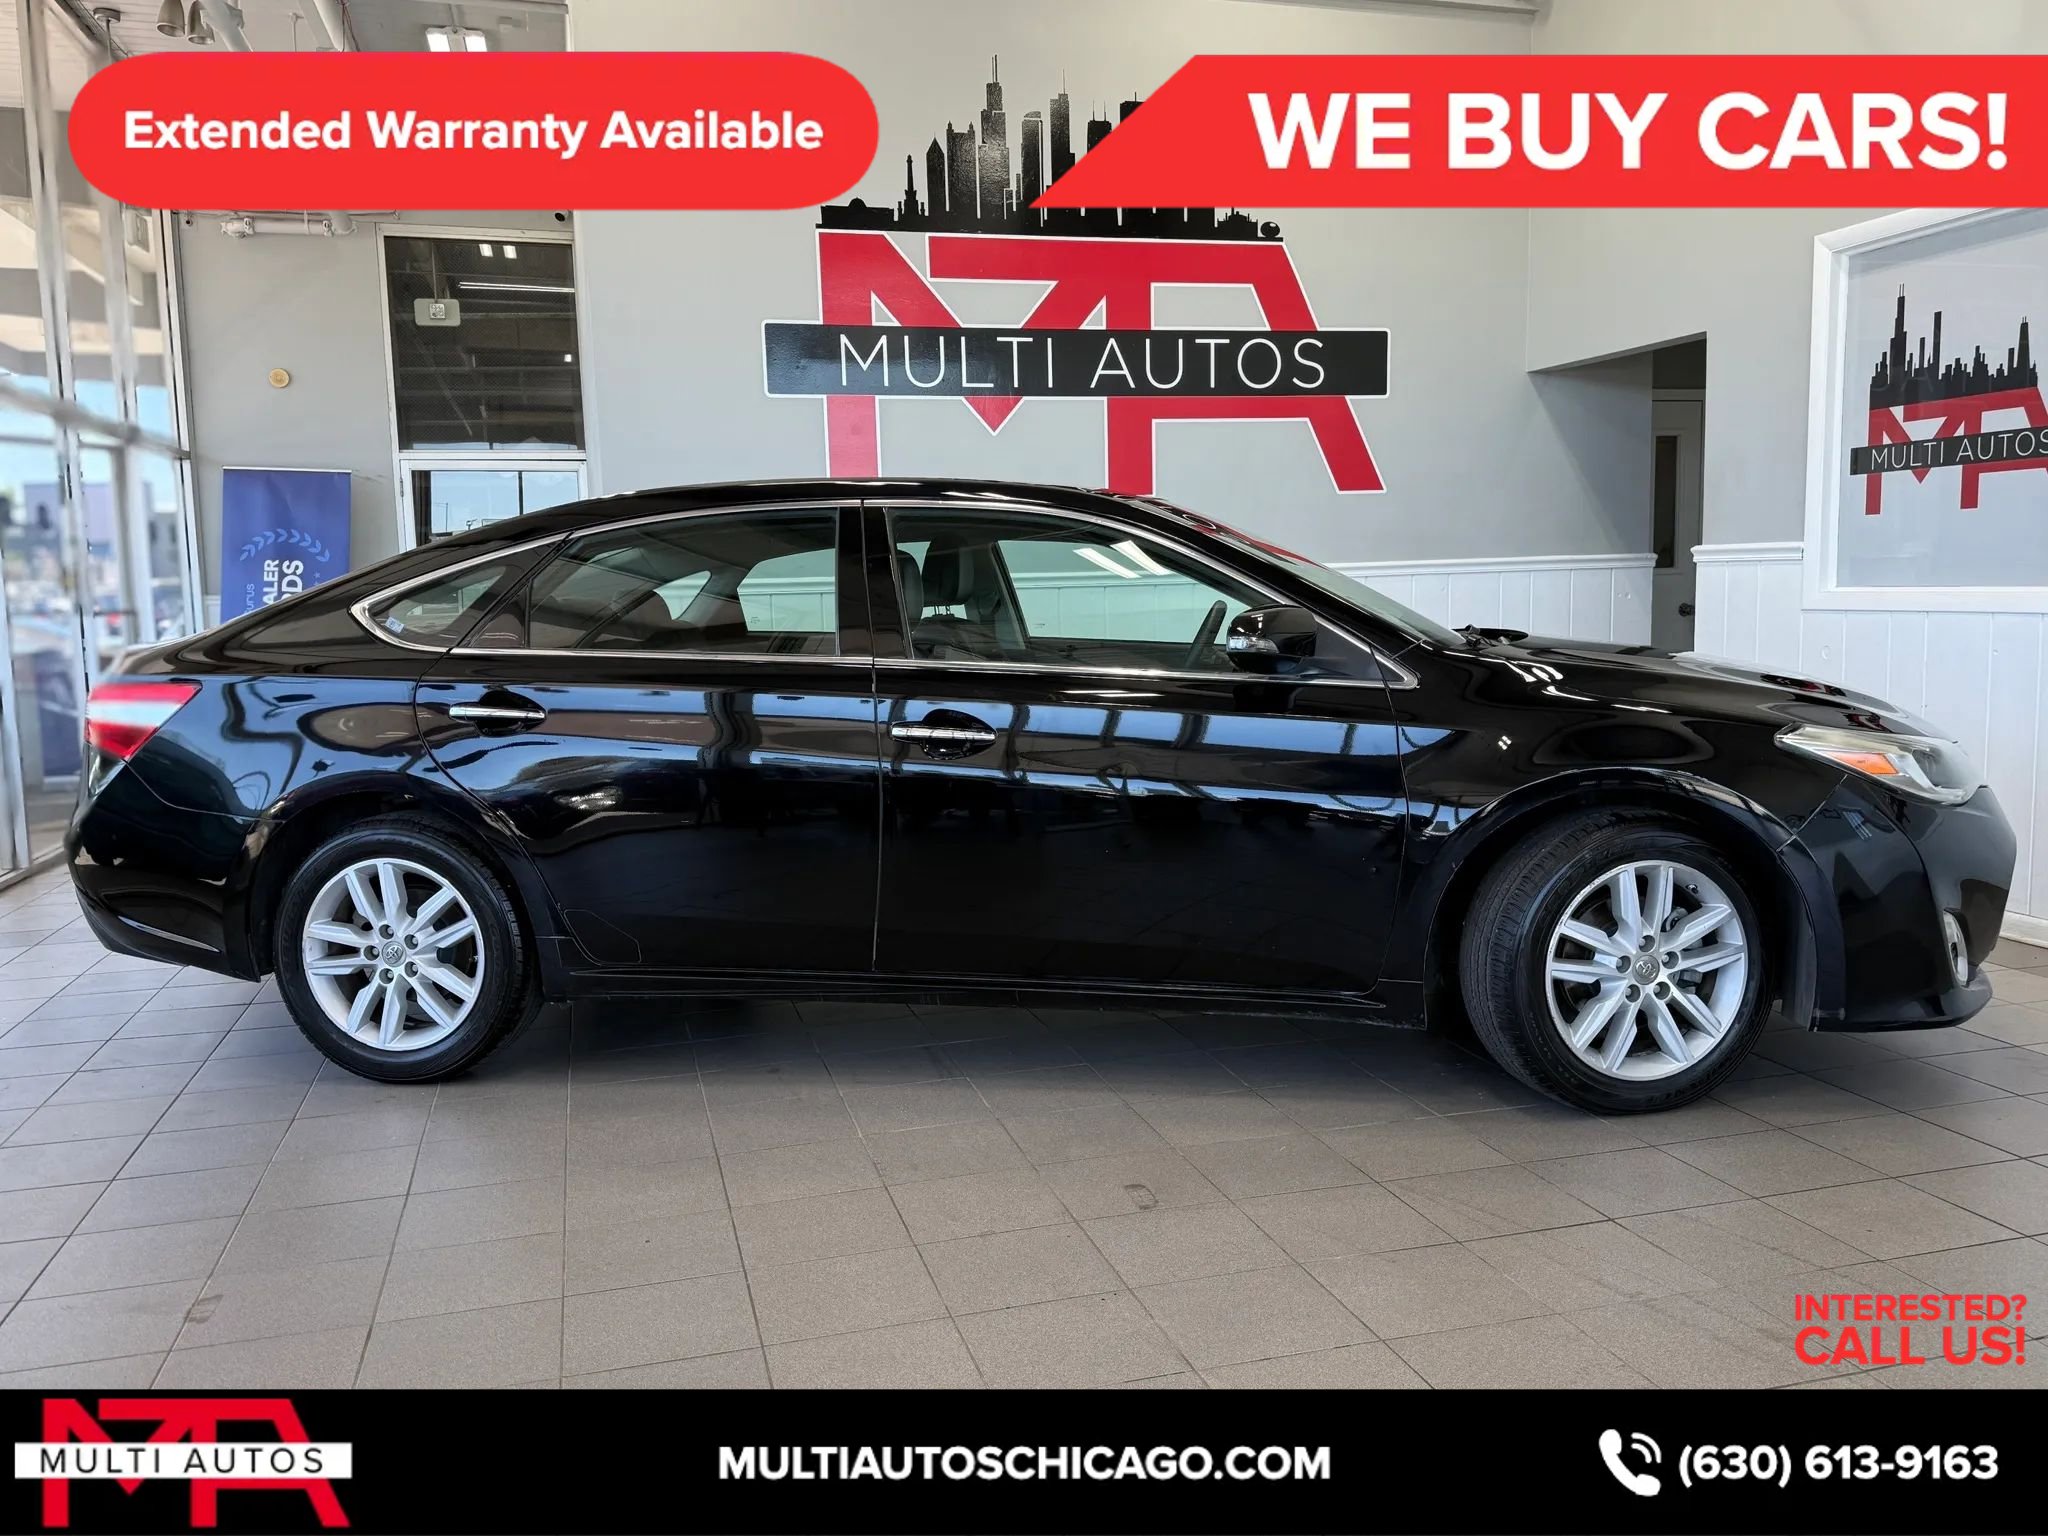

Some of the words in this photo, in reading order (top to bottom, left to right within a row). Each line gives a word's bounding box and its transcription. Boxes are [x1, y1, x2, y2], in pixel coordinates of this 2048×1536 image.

[839, 333, 1053, 389] MULTI
[1091, 337, 1325, 389] AUTOS
[1871, 441, 1944, 471] MULTI
[1956, 431, 2048, 462] AUTOS
[263, 559, 279, 604] ALER
